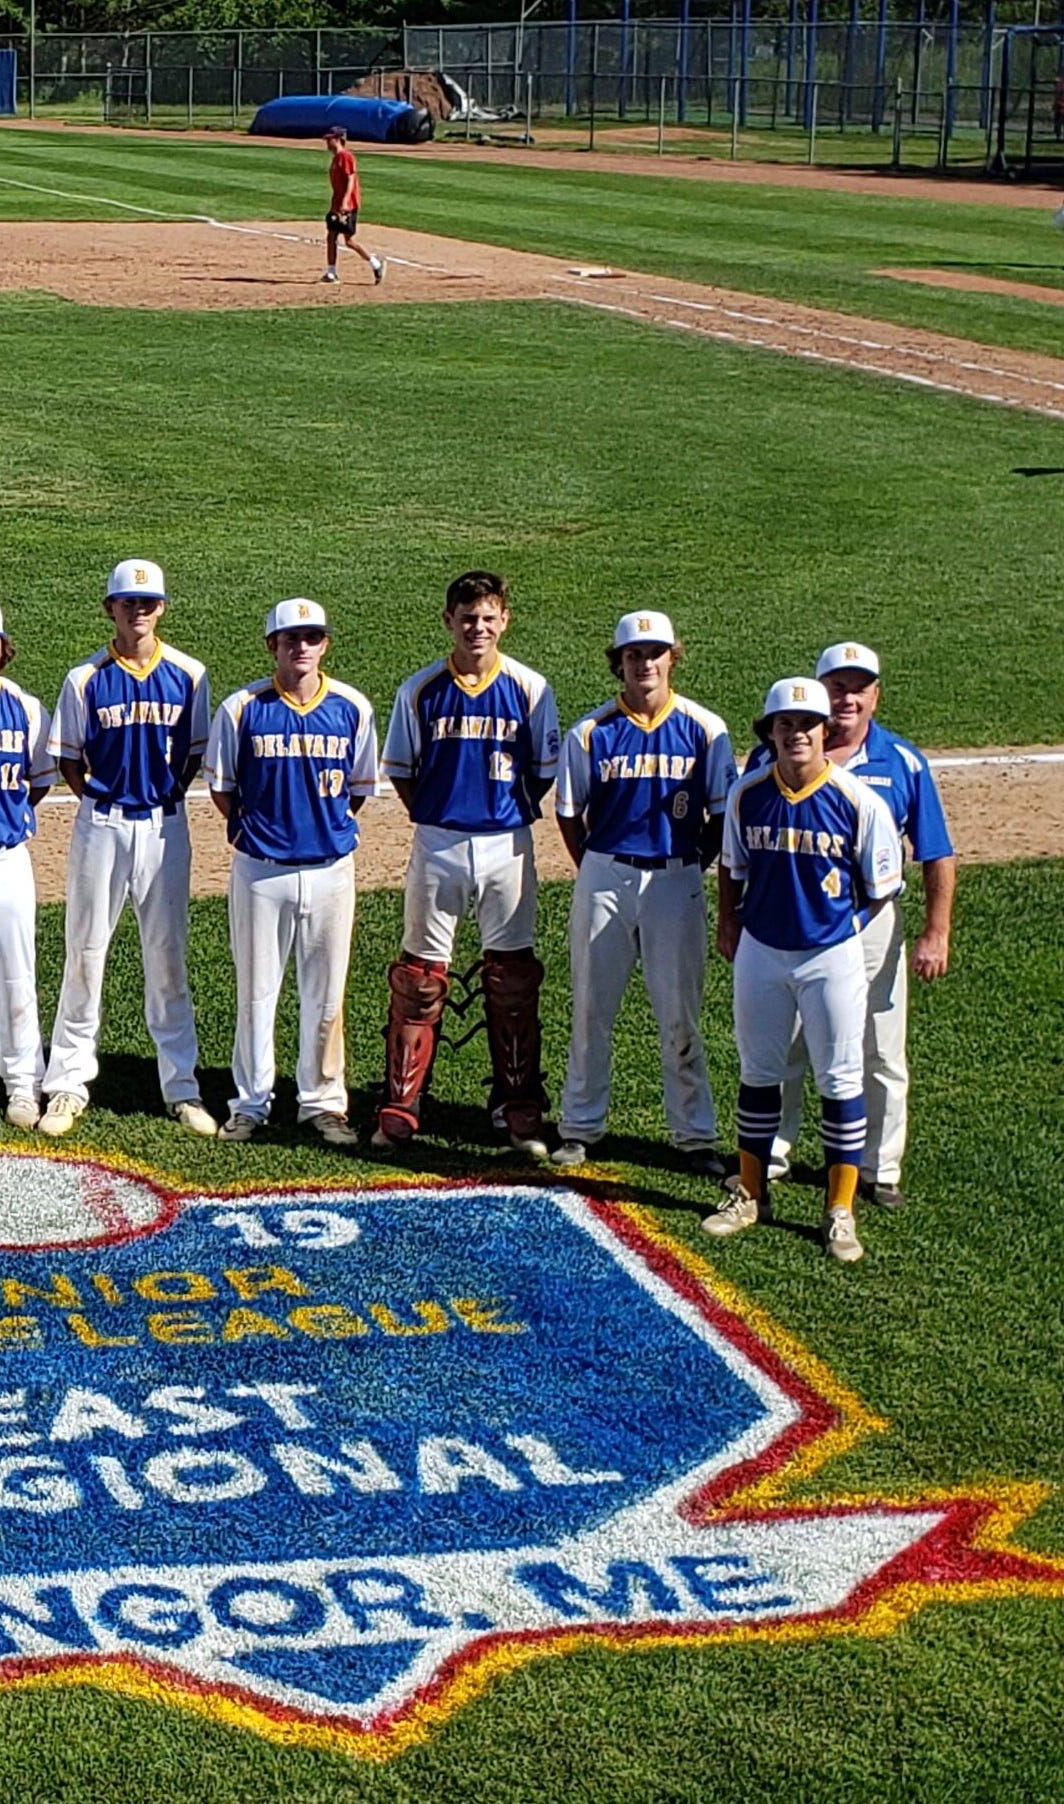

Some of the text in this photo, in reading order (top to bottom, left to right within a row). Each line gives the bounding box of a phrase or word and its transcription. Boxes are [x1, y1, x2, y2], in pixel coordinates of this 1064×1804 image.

[97, 701, 184, 729] DELAWARE
[432, 716, 518, 742] DELAWARE
[251, 733, 351, 759] DELAWARE
[489, 751, 515, 782] 12
[598, 754, 697, 784] DELAWARE
[318, 769, 345, 798] 13
[672, 791, 690, 820] 6
[821, 867, 842, 898] 4
[210, 1209, 363, 1249] 19
[67, 1295, 530, 1349] LEAGUE
[515, 1553, 789, 1626] ME
